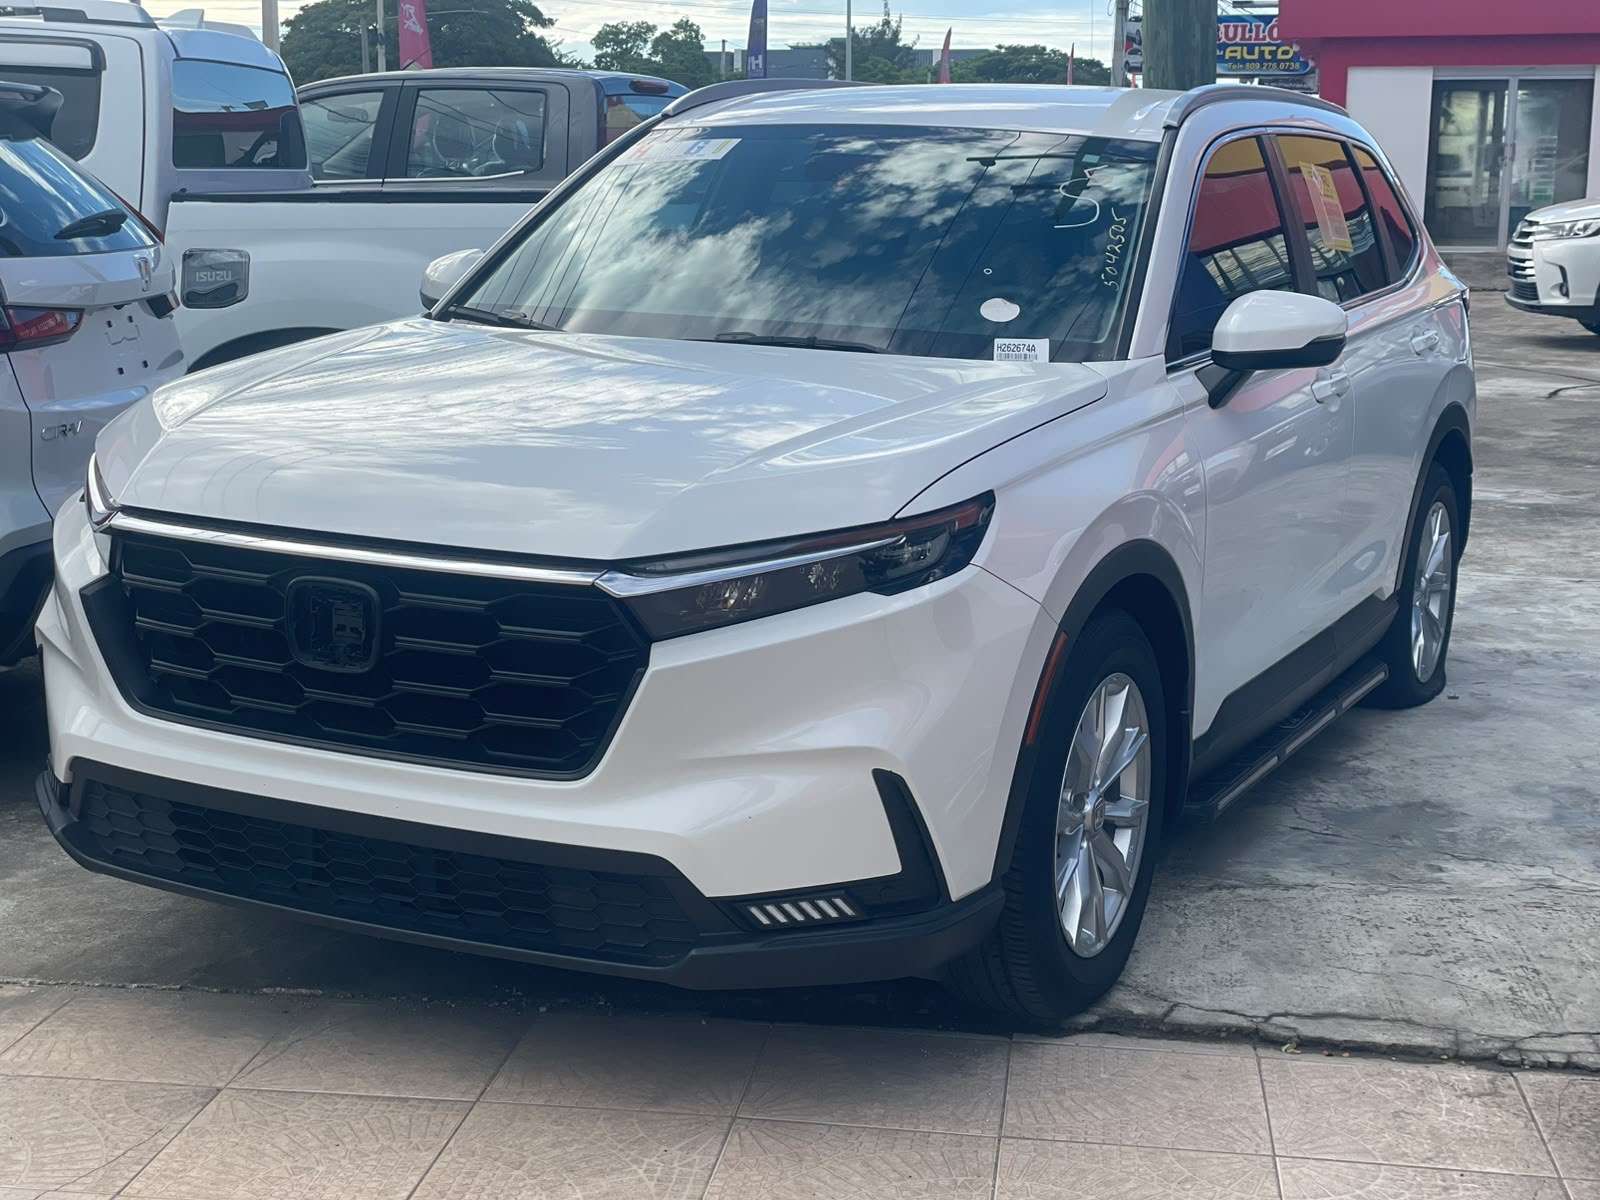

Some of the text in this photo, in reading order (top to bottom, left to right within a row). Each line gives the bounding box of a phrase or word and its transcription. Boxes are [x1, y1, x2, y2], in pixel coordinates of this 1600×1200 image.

[1225, 46, 1294, 60] AUTO
[195, 271, 232, 282] ISUZU
[996, 343, 1036, 353] H262674A
